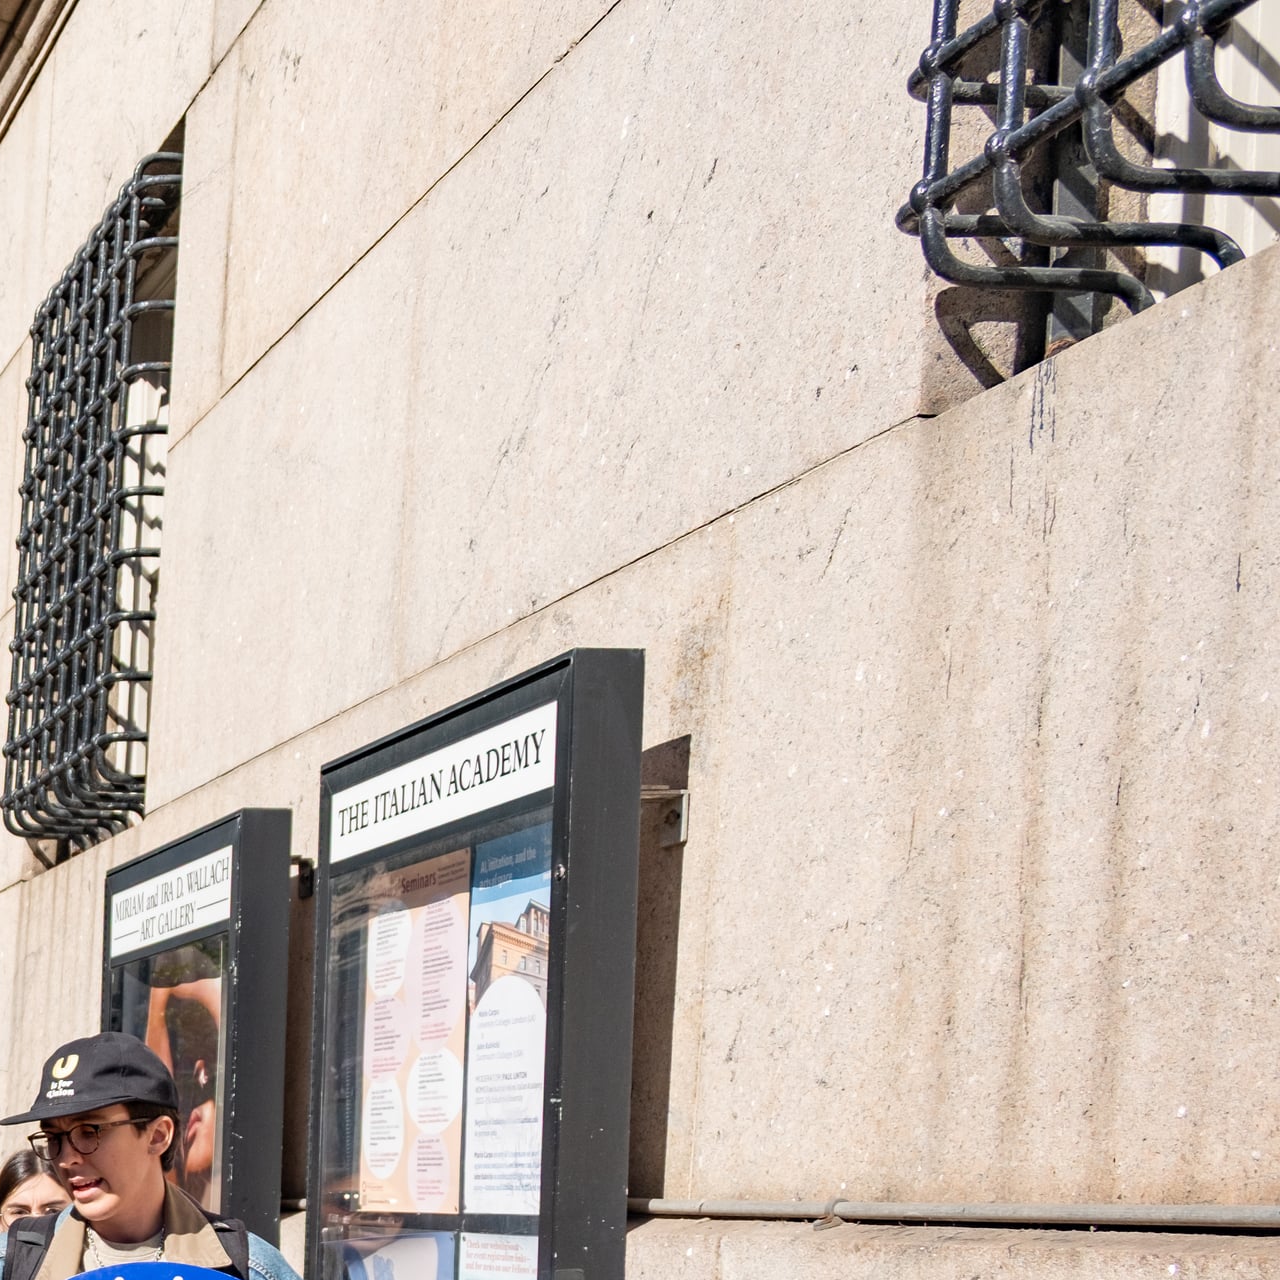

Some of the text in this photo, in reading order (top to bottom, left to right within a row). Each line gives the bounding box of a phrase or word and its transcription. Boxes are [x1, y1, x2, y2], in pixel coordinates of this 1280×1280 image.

[339, 728, 546, 837] THE ITALIAN ACADEMY
[114, 856, 230, 923] MIRIAM and IRA D. WALLACH
[401, 871, 437, 894] Seminars
[140, 901, 196, 942] ART GALLERY
[58, 1080, 74, 1090] for
